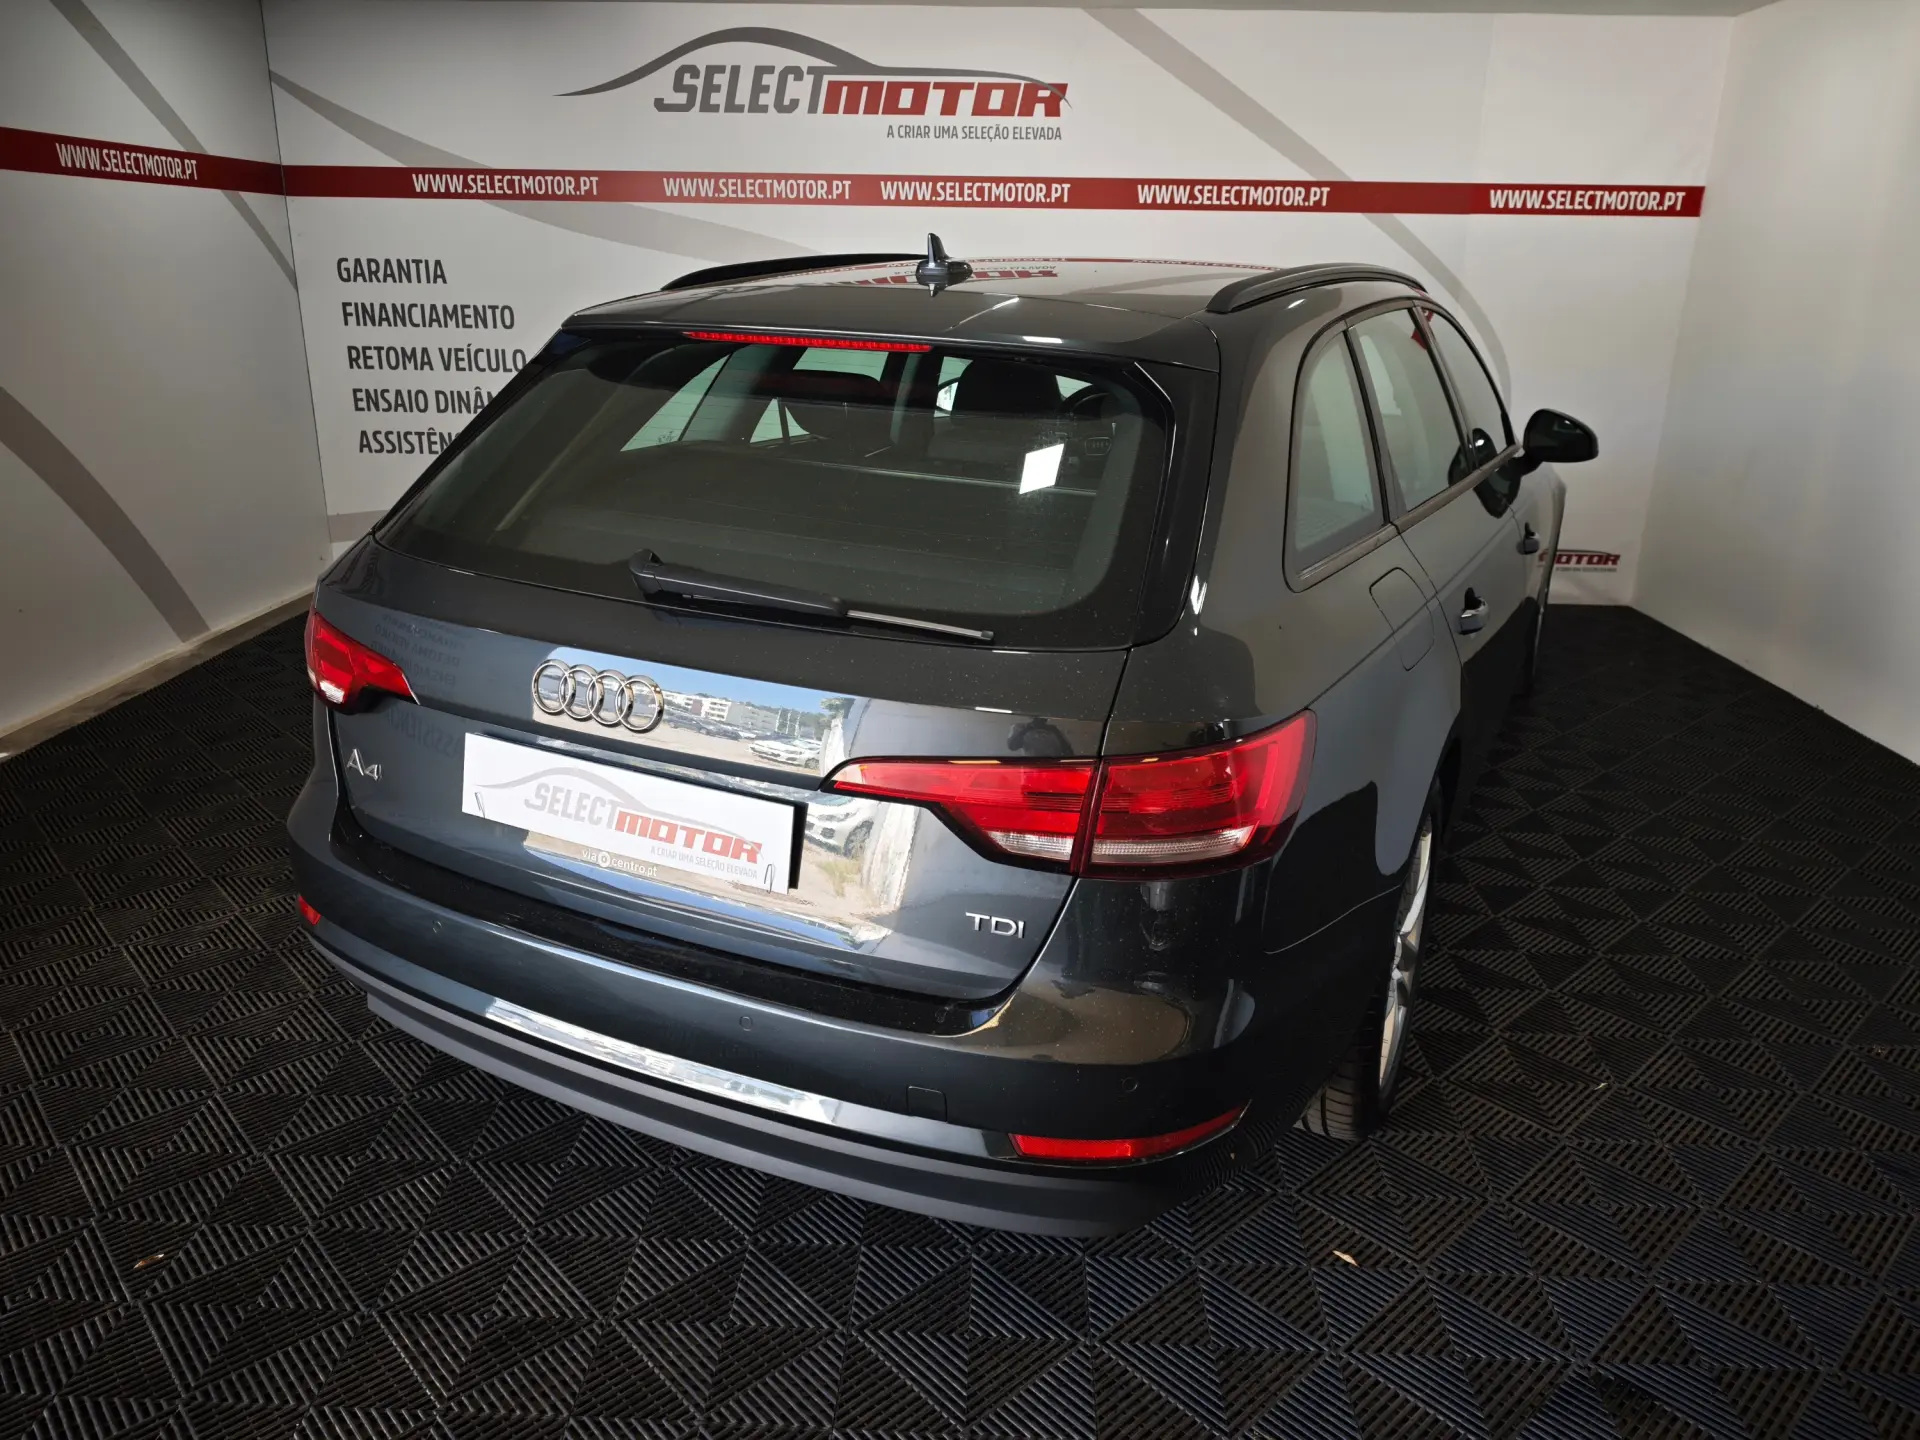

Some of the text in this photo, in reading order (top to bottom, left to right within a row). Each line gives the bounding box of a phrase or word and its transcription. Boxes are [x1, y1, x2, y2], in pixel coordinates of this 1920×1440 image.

[653, 64, 1069, 117] SELECTMOTOR
[887, 123, 1062, 142] A CRIAR UMA SELEÇÃO ELEVADA
[55, 143, 198, 181] WWW.SELECTMOTOR.PT
[412, 173, 598, 196] WWW.SELECTMOTOR.PT
[662, 177, 851, 199] WWW.SELECTMOTOR.PT
[880, 181, 1071, 203] WWW.SELECTMOTOR.PT
[1137, 184, 1330, 206] WWW.SELECTMOTOR.PT
[1489, 189, 1685, 211] WWW.SELECTMOTOR.PT
[336, 257, 448, 284] GARANTIA
[341, 302, 515, 329] FINANCIAMENTO
[347, 343, 527, 373] RETOMA VEÍCULO
[352, 388, 429, 413] ENSAIO
[359, 427, 460, 455] ASSISTÊN
[347, 749, 382, 781] A4
[524, 782, 763, 864] SELECTMOTOR
[656, 847, 678, 860] CRIAR
[678, 851, 694, 864] UMA
[726, 862, 758, 879] ELEVADA
[965, 912, 1025, 938] TDI
